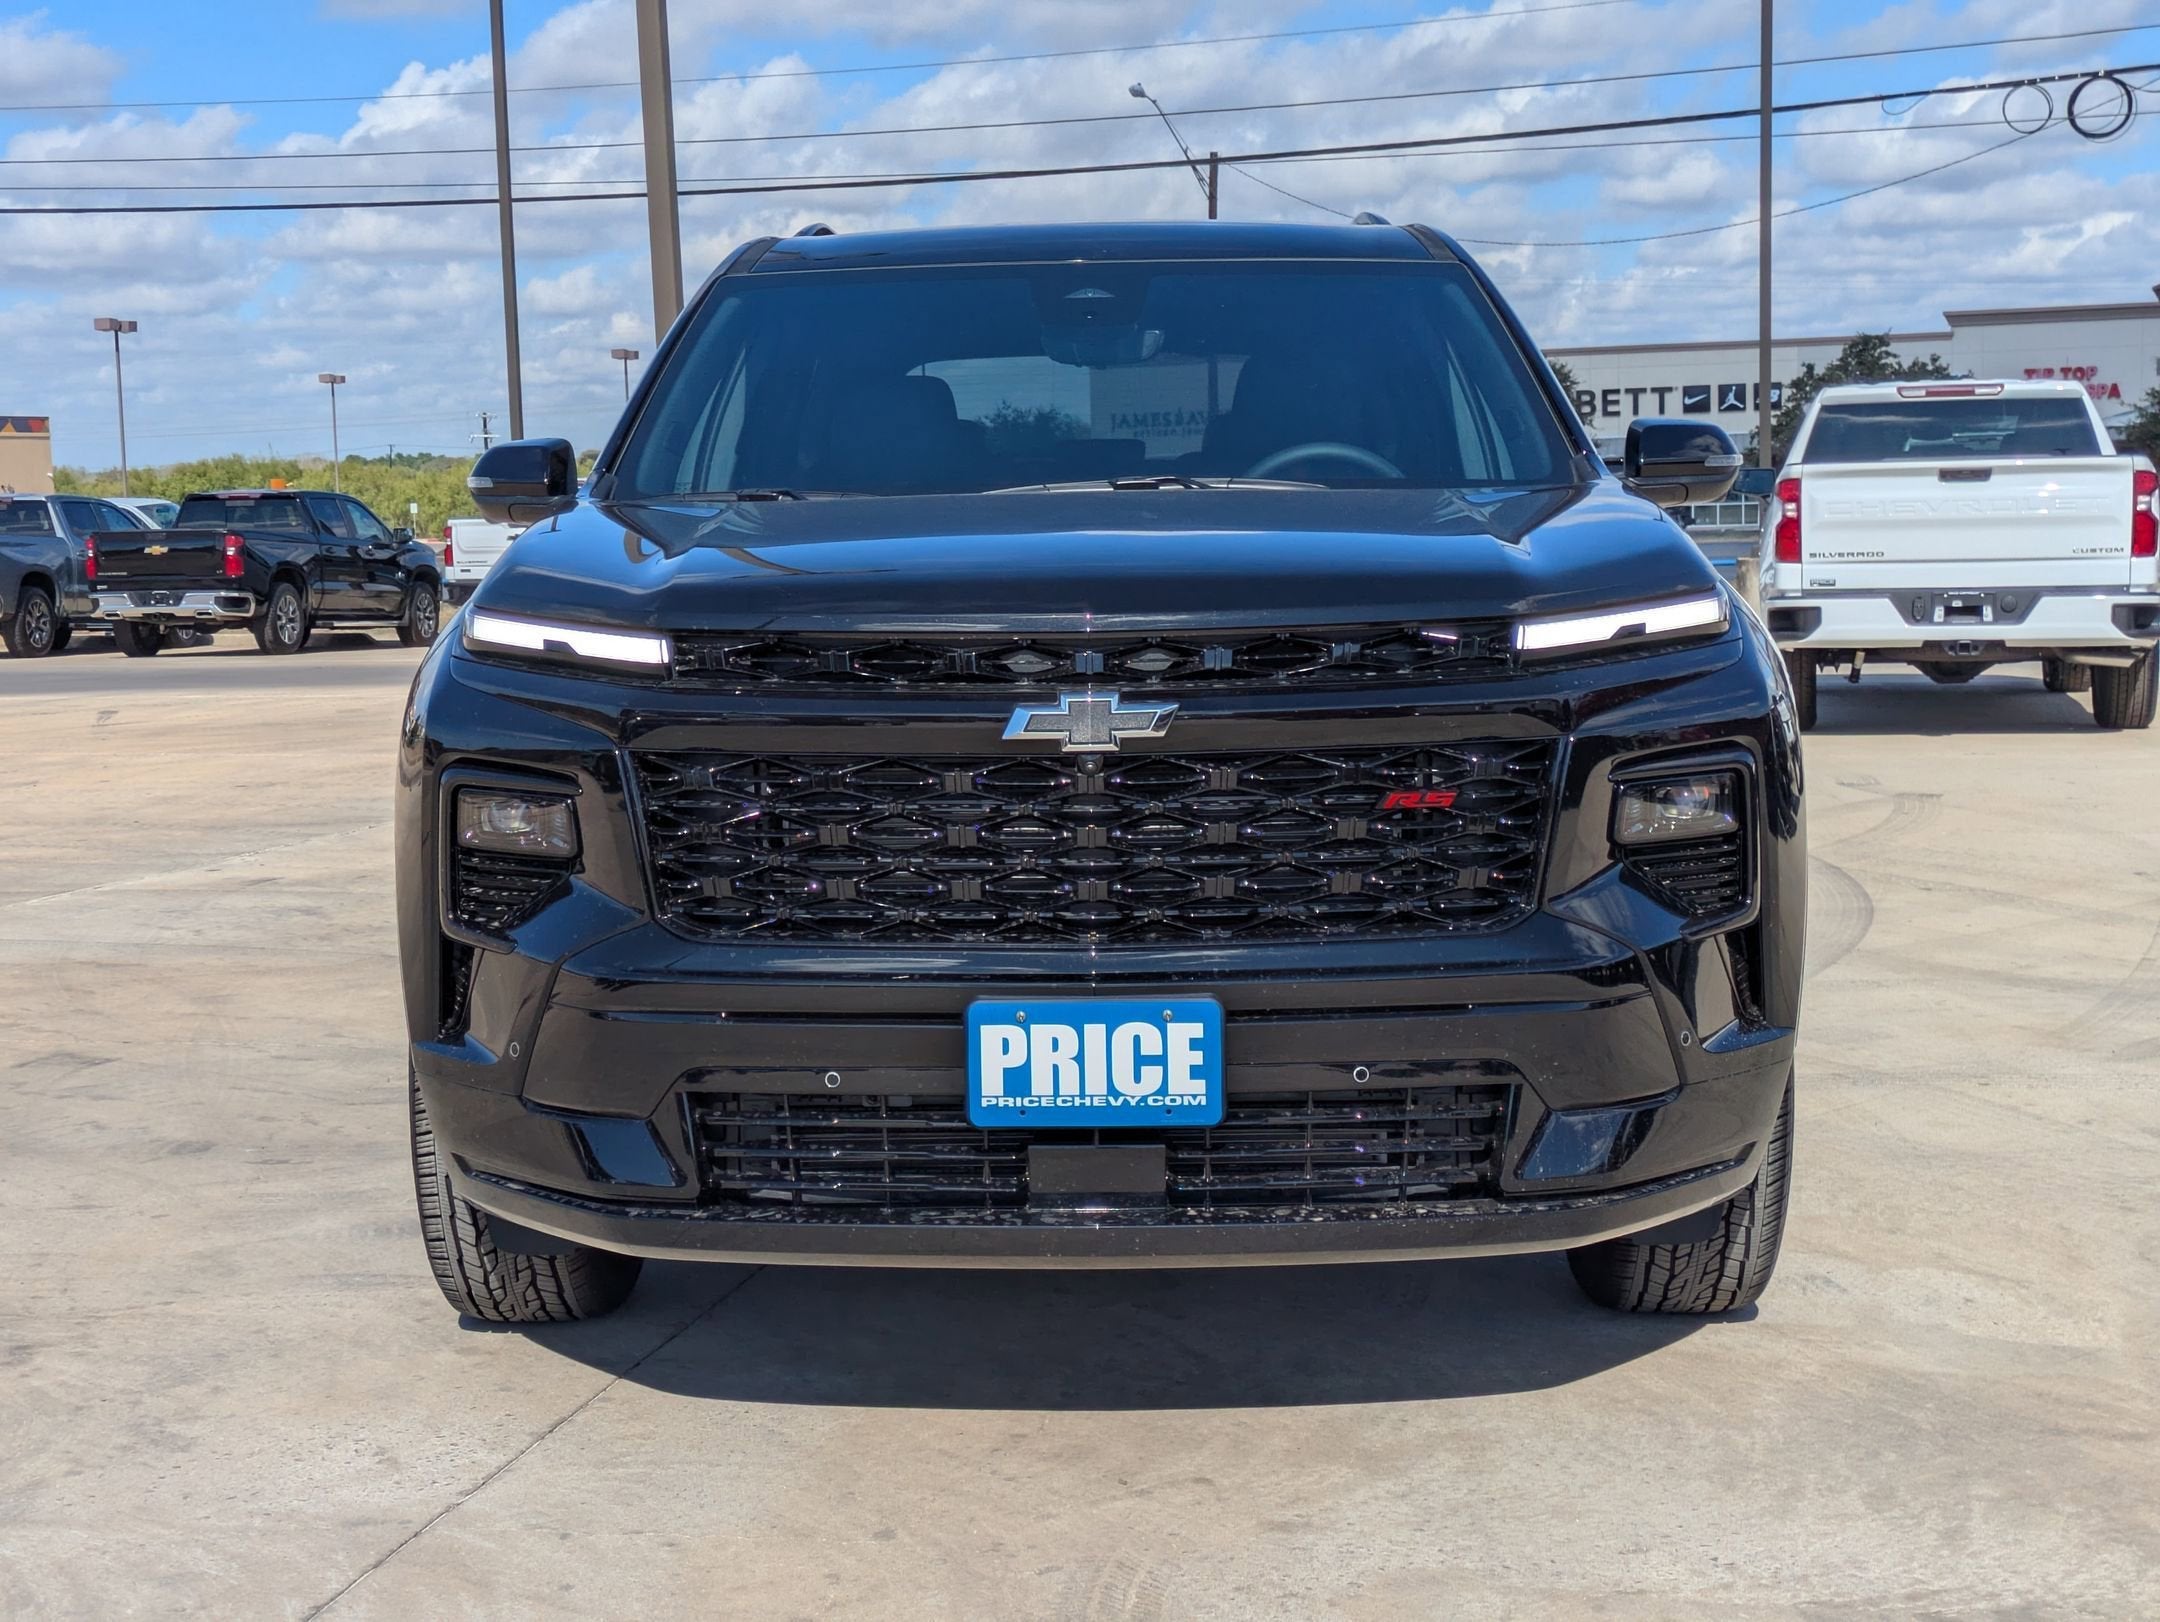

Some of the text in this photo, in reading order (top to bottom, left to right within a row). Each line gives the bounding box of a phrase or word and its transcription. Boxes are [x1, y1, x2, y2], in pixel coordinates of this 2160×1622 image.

[2060, 366, 2098, 381] TOP
[2086, 383, 2121, 399] SPA
[1111, 411, 1173, 432] JAMES
[1824, 497, 2111, 517] CHEVROLET
[1808, 551, 1885, 559] SILVERADO
[2072, 546, 2124, 554] CUSTOM
[1383, 791, 1457, 809] RS
[980, 1022, 1207, 1096] PRICE
[981, 1096, 1207, 1107] PRICECHEVY.COM
